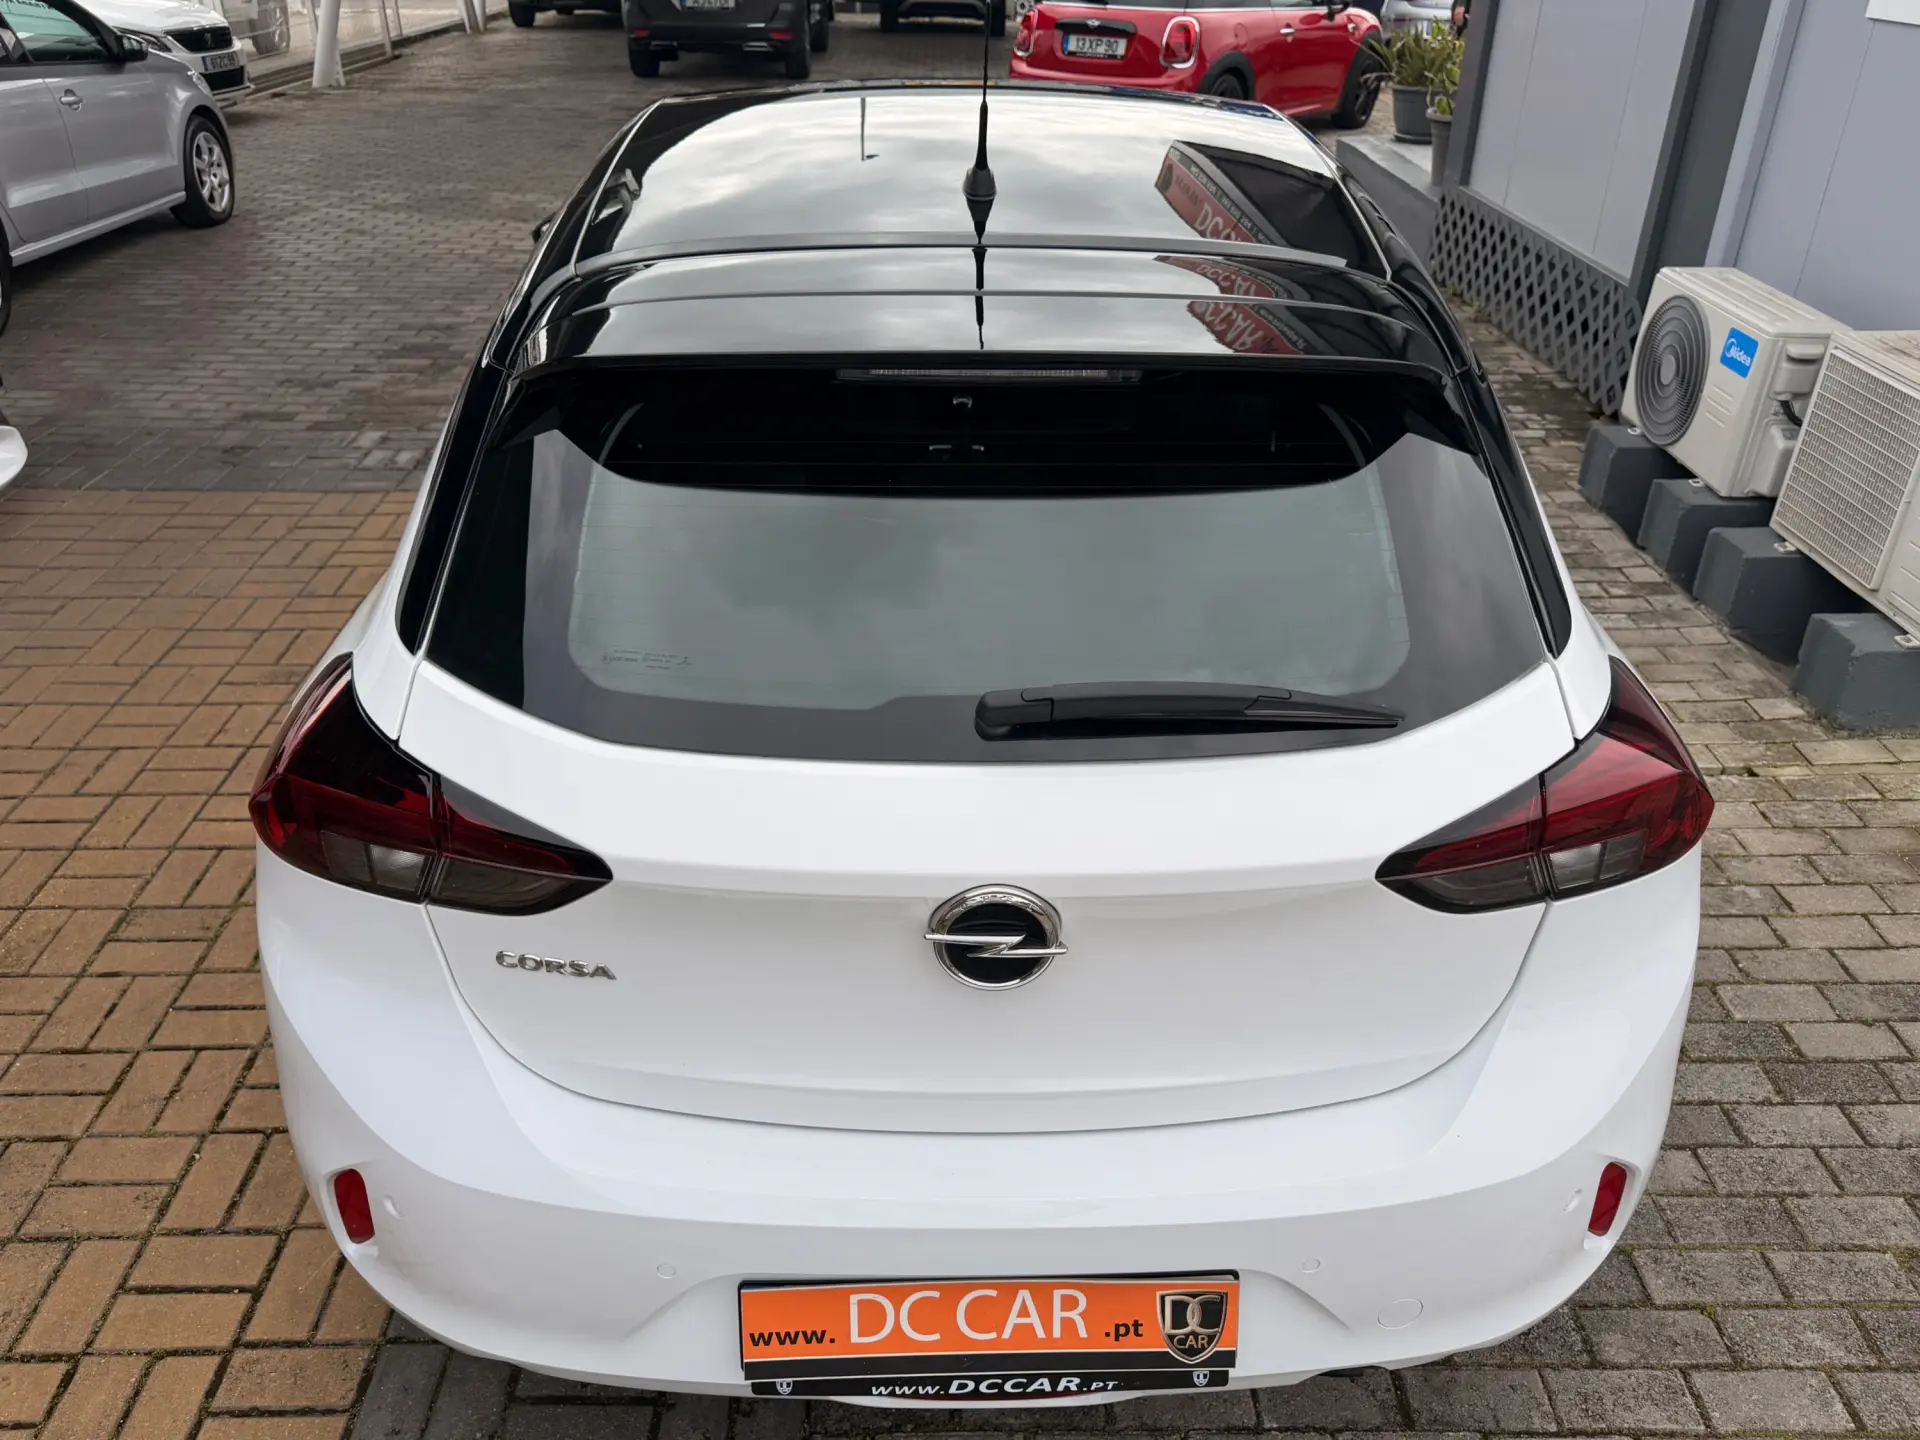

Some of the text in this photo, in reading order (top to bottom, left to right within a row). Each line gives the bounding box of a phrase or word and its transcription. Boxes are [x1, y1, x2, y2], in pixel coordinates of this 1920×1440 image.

[1727, 341, 1751, 367] Midea
[495, 950, 618, 980] CORSA
[749, 1288, 1144, 1347] www. DC CAR .pt
[1164, 1294, 1221, 1335] DC
[1173, 1335, 1209, 1349] CAR
